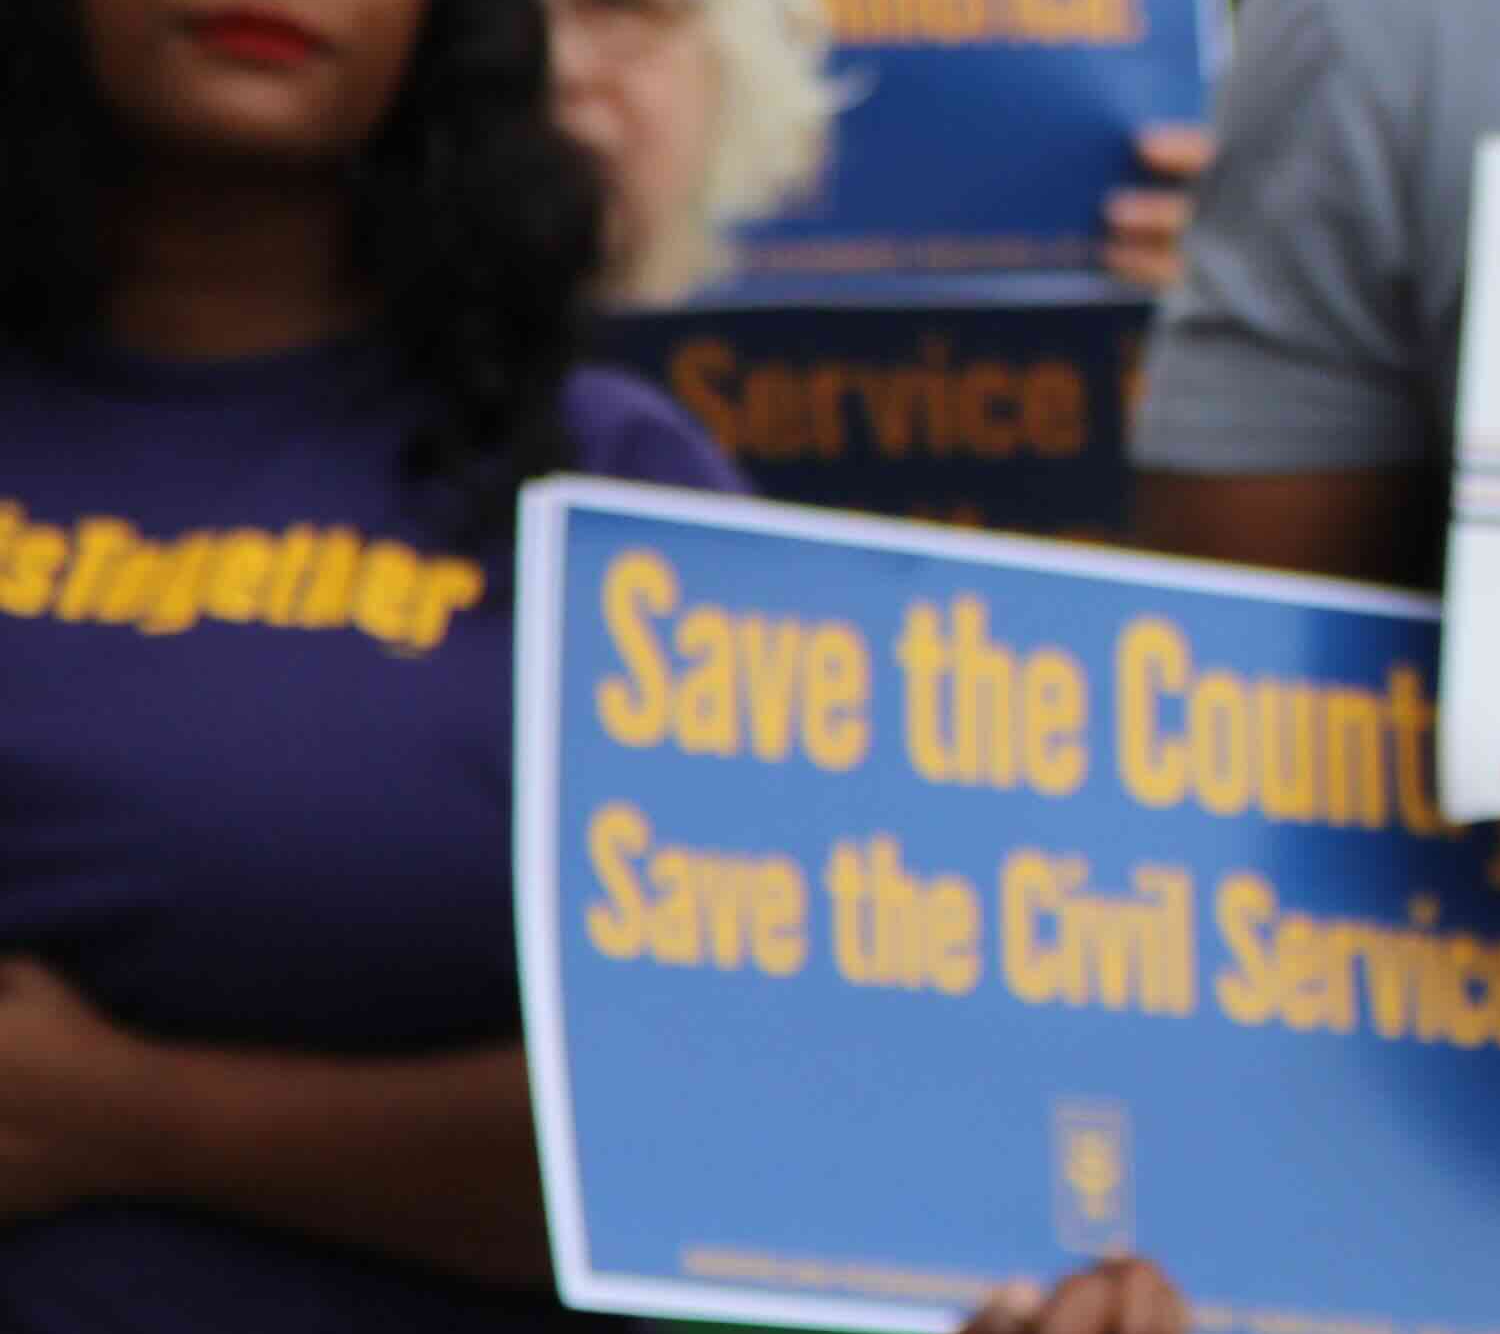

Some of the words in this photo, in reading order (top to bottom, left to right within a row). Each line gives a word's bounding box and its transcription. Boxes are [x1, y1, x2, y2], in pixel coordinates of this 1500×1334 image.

[597, 549, 872, 771] Save
[898, 593, 1090, 795] the
[587, 803, 808, 975] Save
[825, 833, 982, 995] the
[1000, 849, 1196, 1017] Civil
